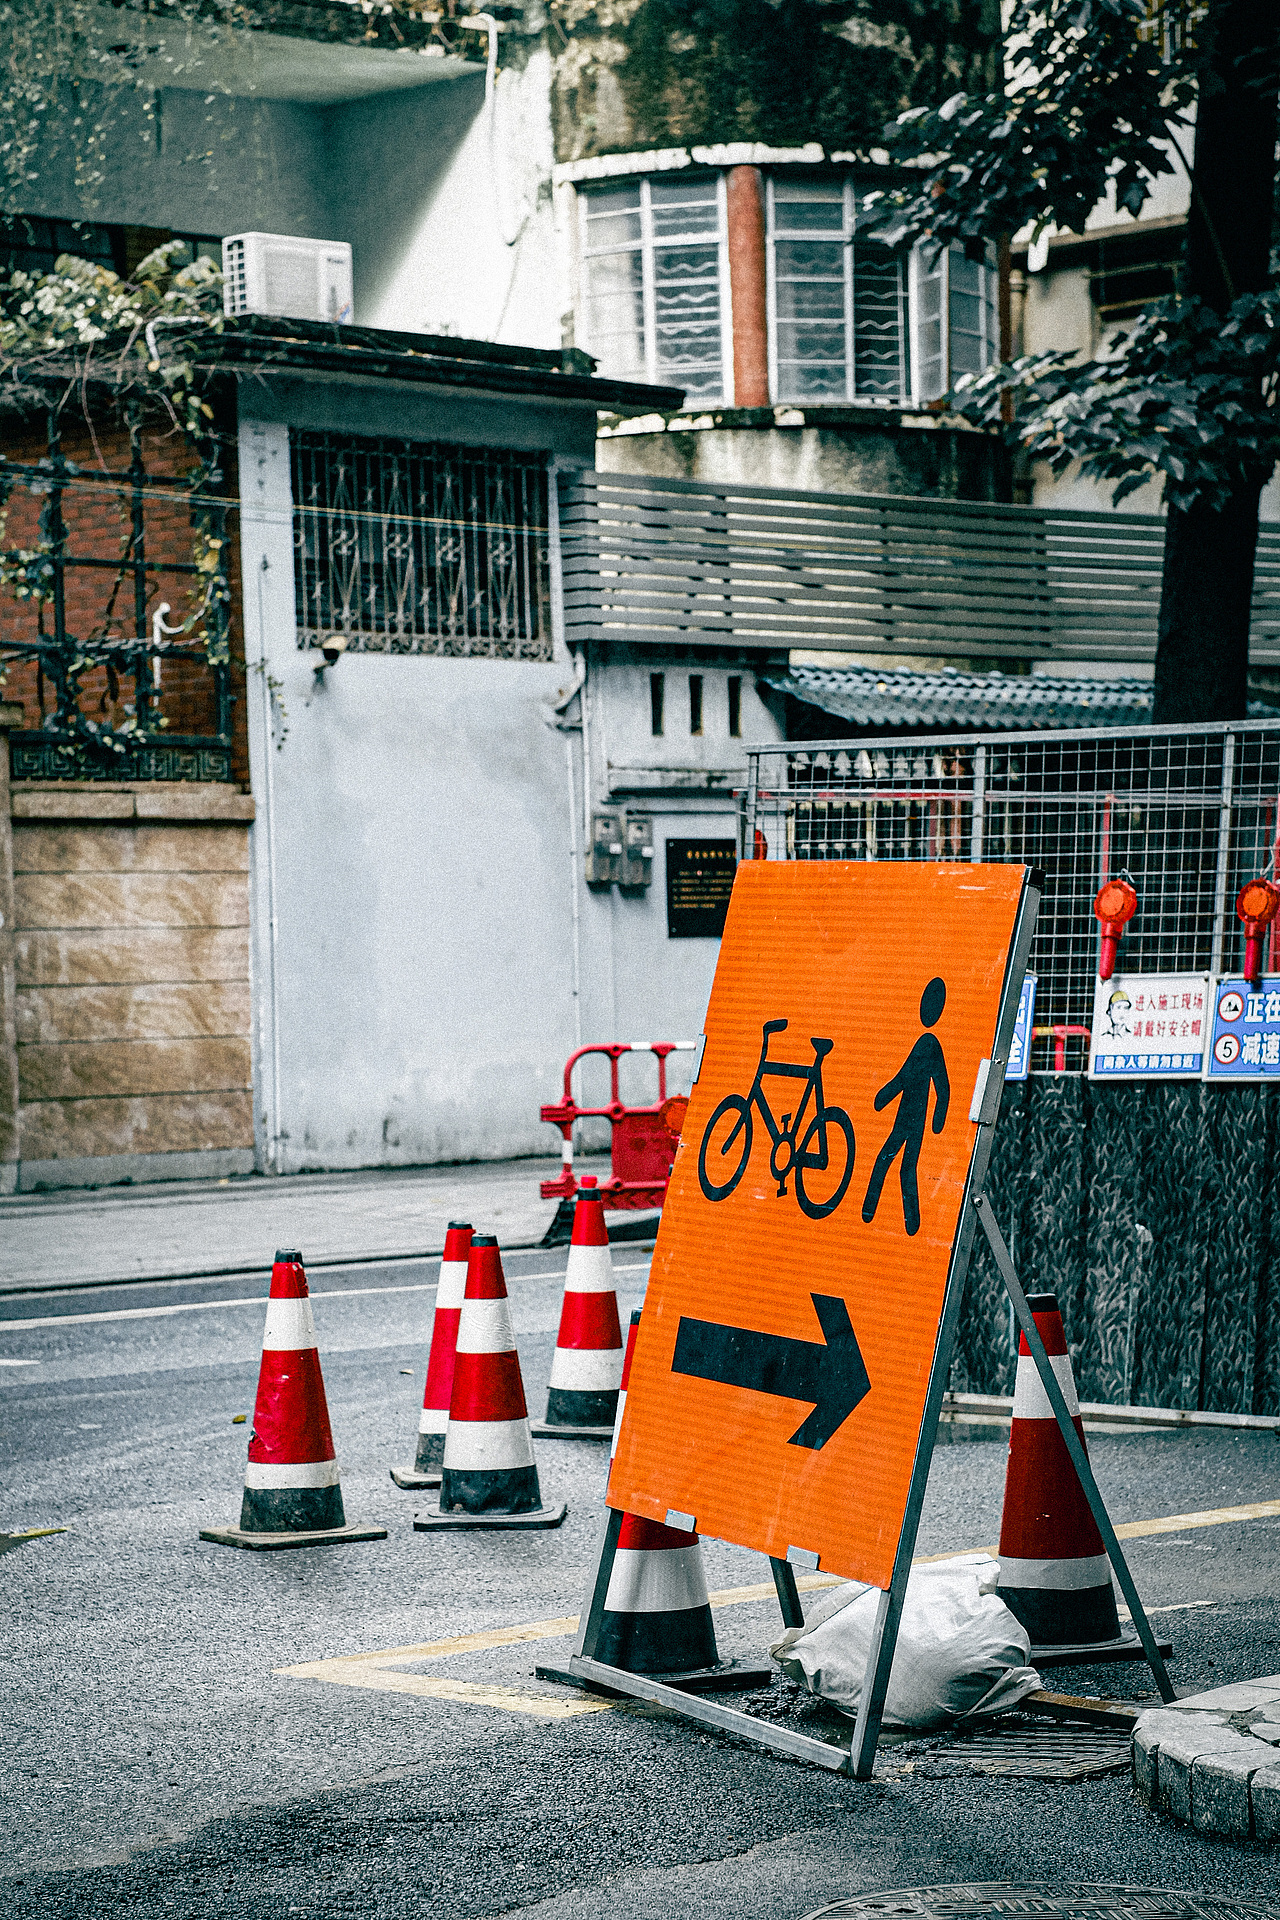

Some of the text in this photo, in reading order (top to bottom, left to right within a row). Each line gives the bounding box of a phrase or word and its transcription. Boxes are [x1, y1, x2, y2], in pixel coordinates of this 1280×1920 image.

[1135, 992, 1203, 1011] 进入施工现场
[1244, 990, 1280, 1023] 正在
[1133, 1019, 1202, 1037] 请戴好安全帽
[1222, 1041, 1233, 1058] 5
[1241, 1032, 1280, 1065] 减速
